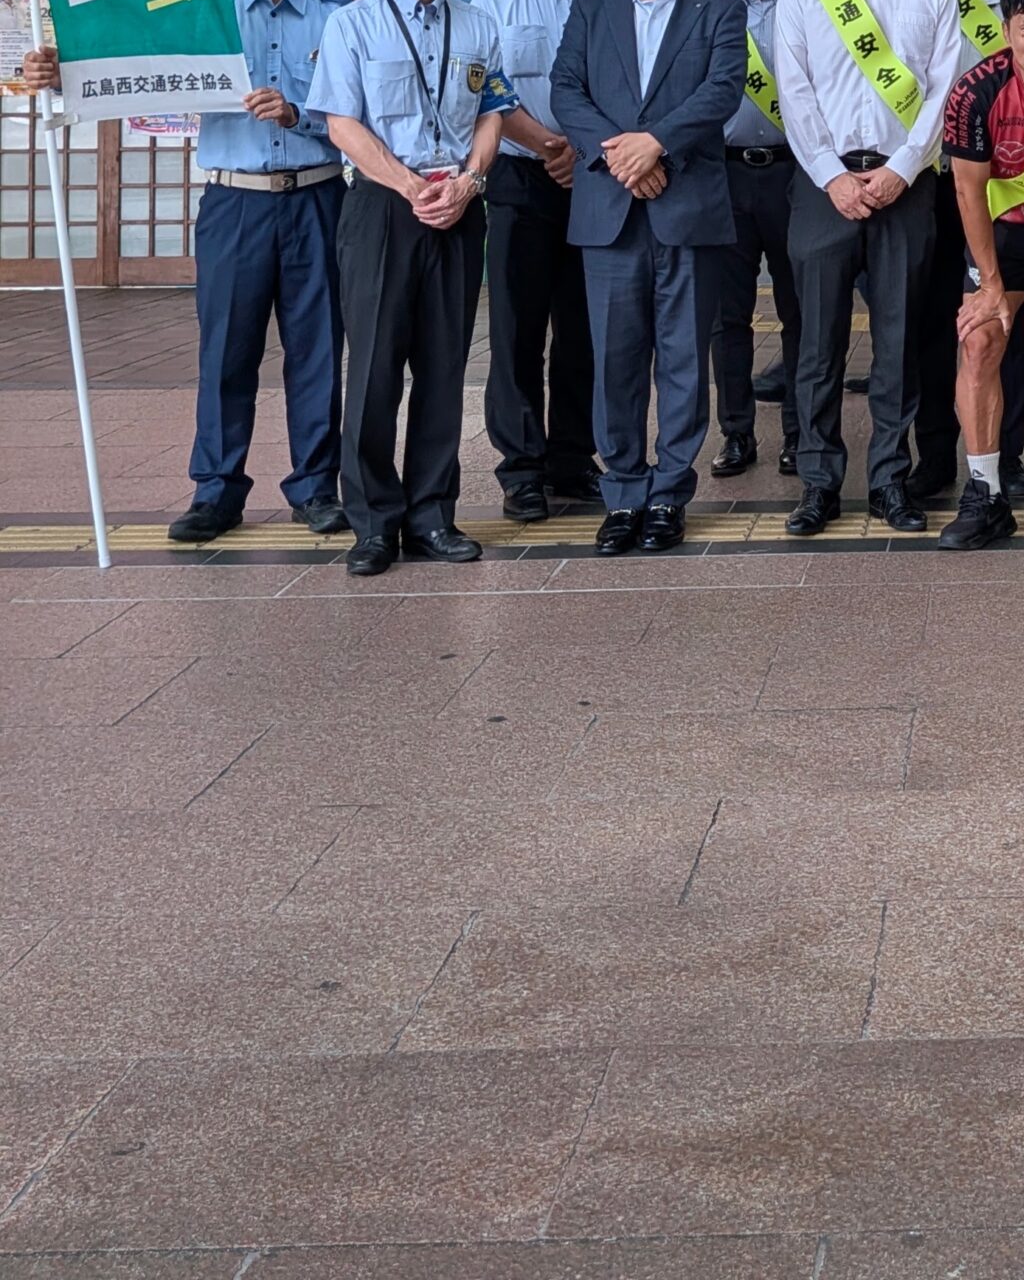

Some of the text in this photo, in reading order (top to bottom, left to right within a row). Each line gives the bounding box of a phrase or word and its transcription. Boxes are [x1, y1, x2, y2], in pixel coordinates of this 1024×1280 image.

[82, 73, 233, 99] 広島西交通安全協会
[958, 91, 977, 149] HIROSHIMA
